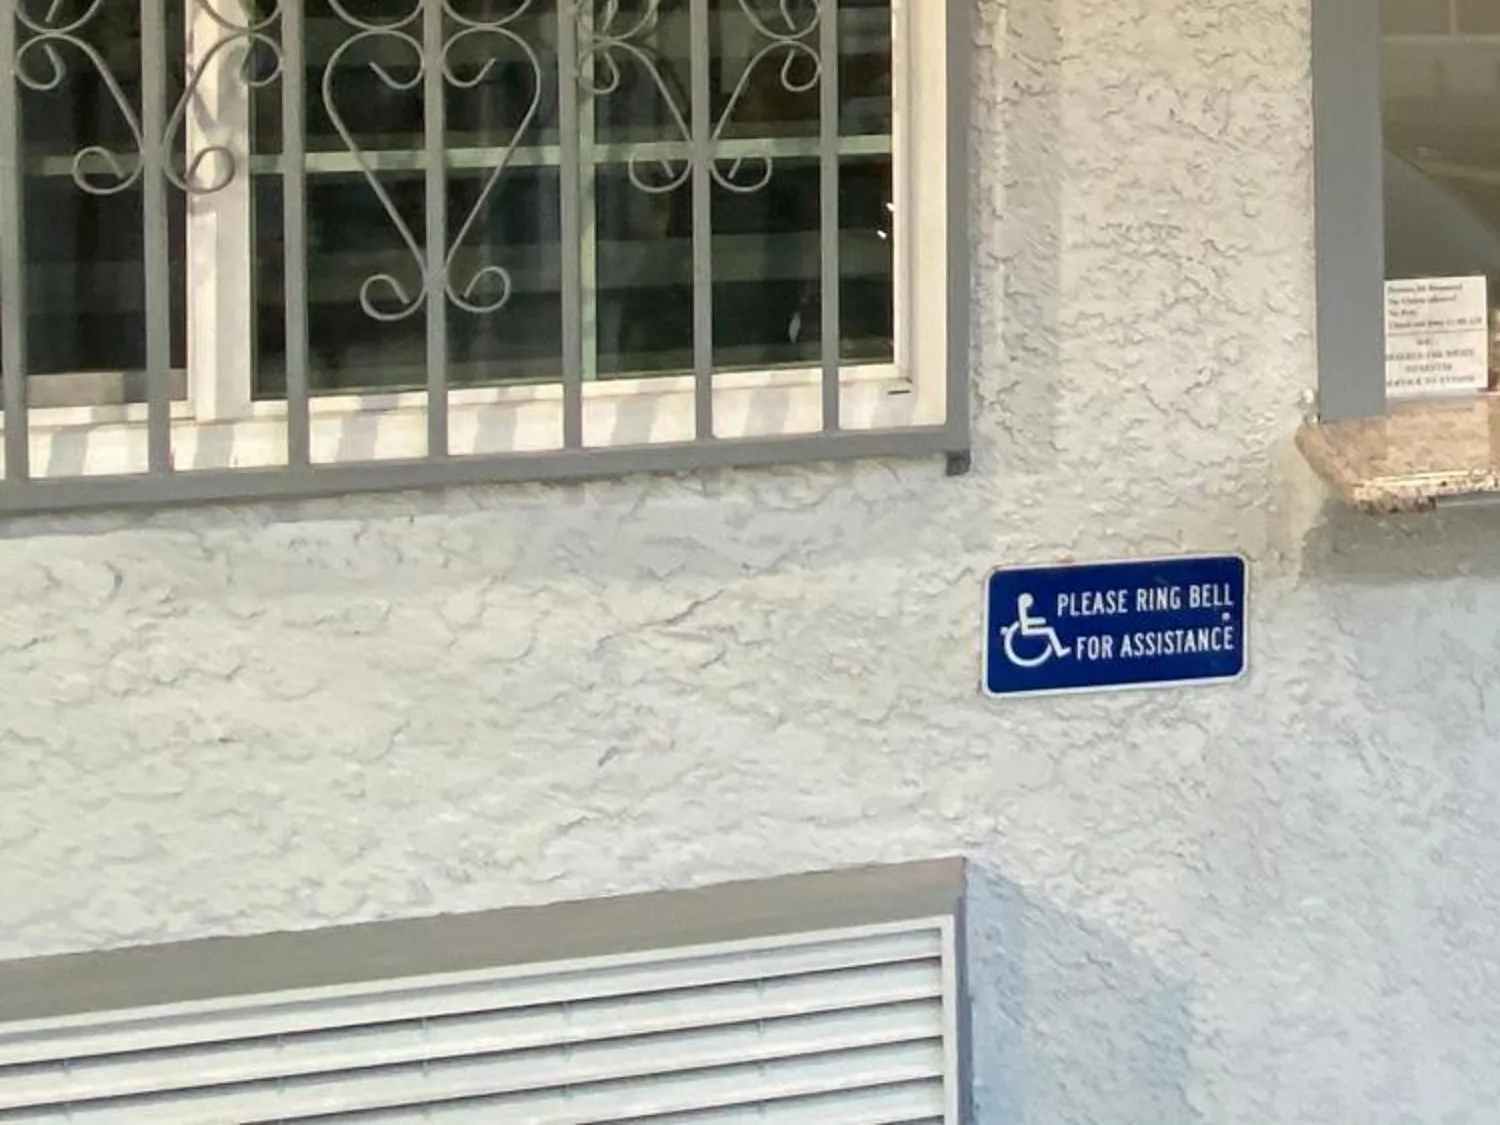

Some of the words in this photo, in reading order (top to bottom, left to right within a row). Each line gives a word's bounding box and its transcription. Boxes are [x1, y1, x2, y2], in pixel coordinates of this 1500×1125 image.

[1056, 589, 1128, 618] PLEASE
[1135, 585, 1181, 612] RING
[1188, 582, 1234, 608] BELL
[1076, 636, 1113, 661] FOR
[1119, 626, 1235, 659] ASSISTANCE
